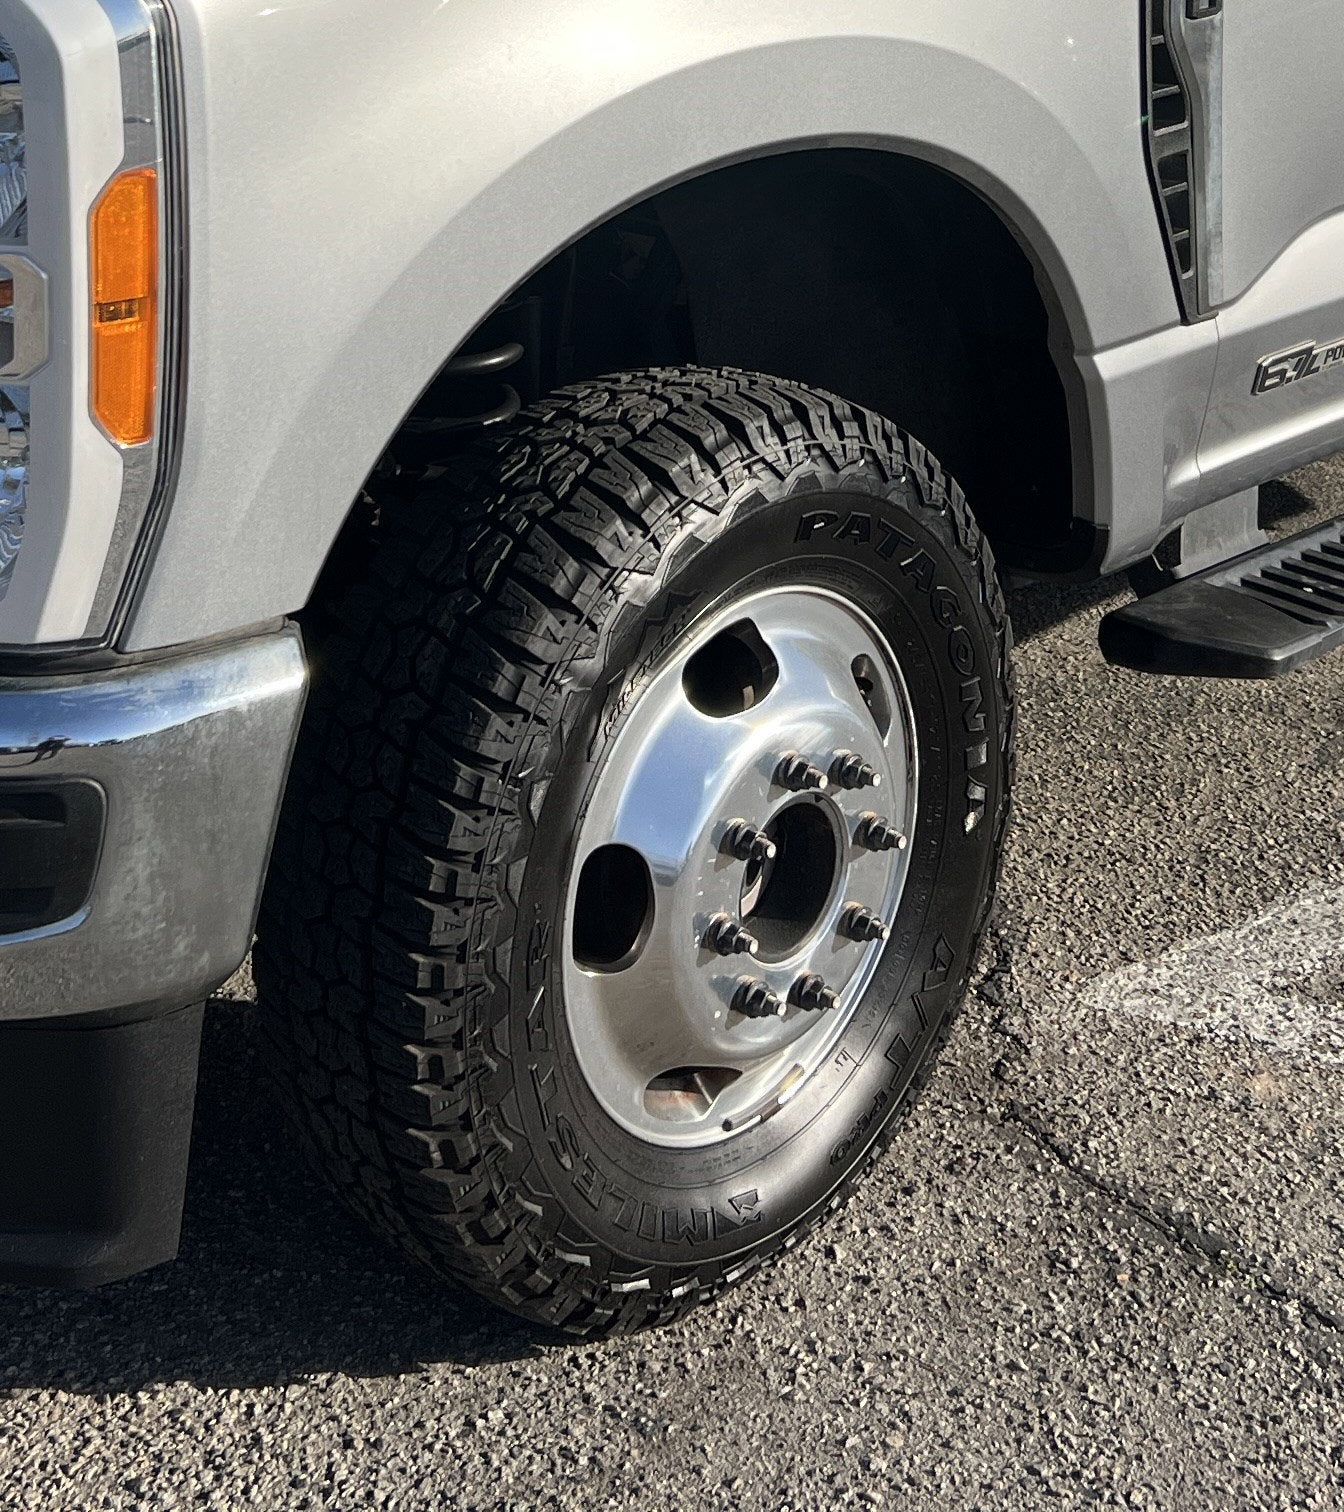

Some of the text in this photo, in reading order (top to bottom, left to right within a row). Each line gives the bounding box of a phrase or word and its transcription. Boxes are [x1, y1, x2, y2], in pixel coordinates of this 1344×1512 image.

[1253, 344, 1321, 394] 6.7L
[794, 510, 988, 834] PATAGONIA
[527, 918, 709, 1246] MILESTAR
